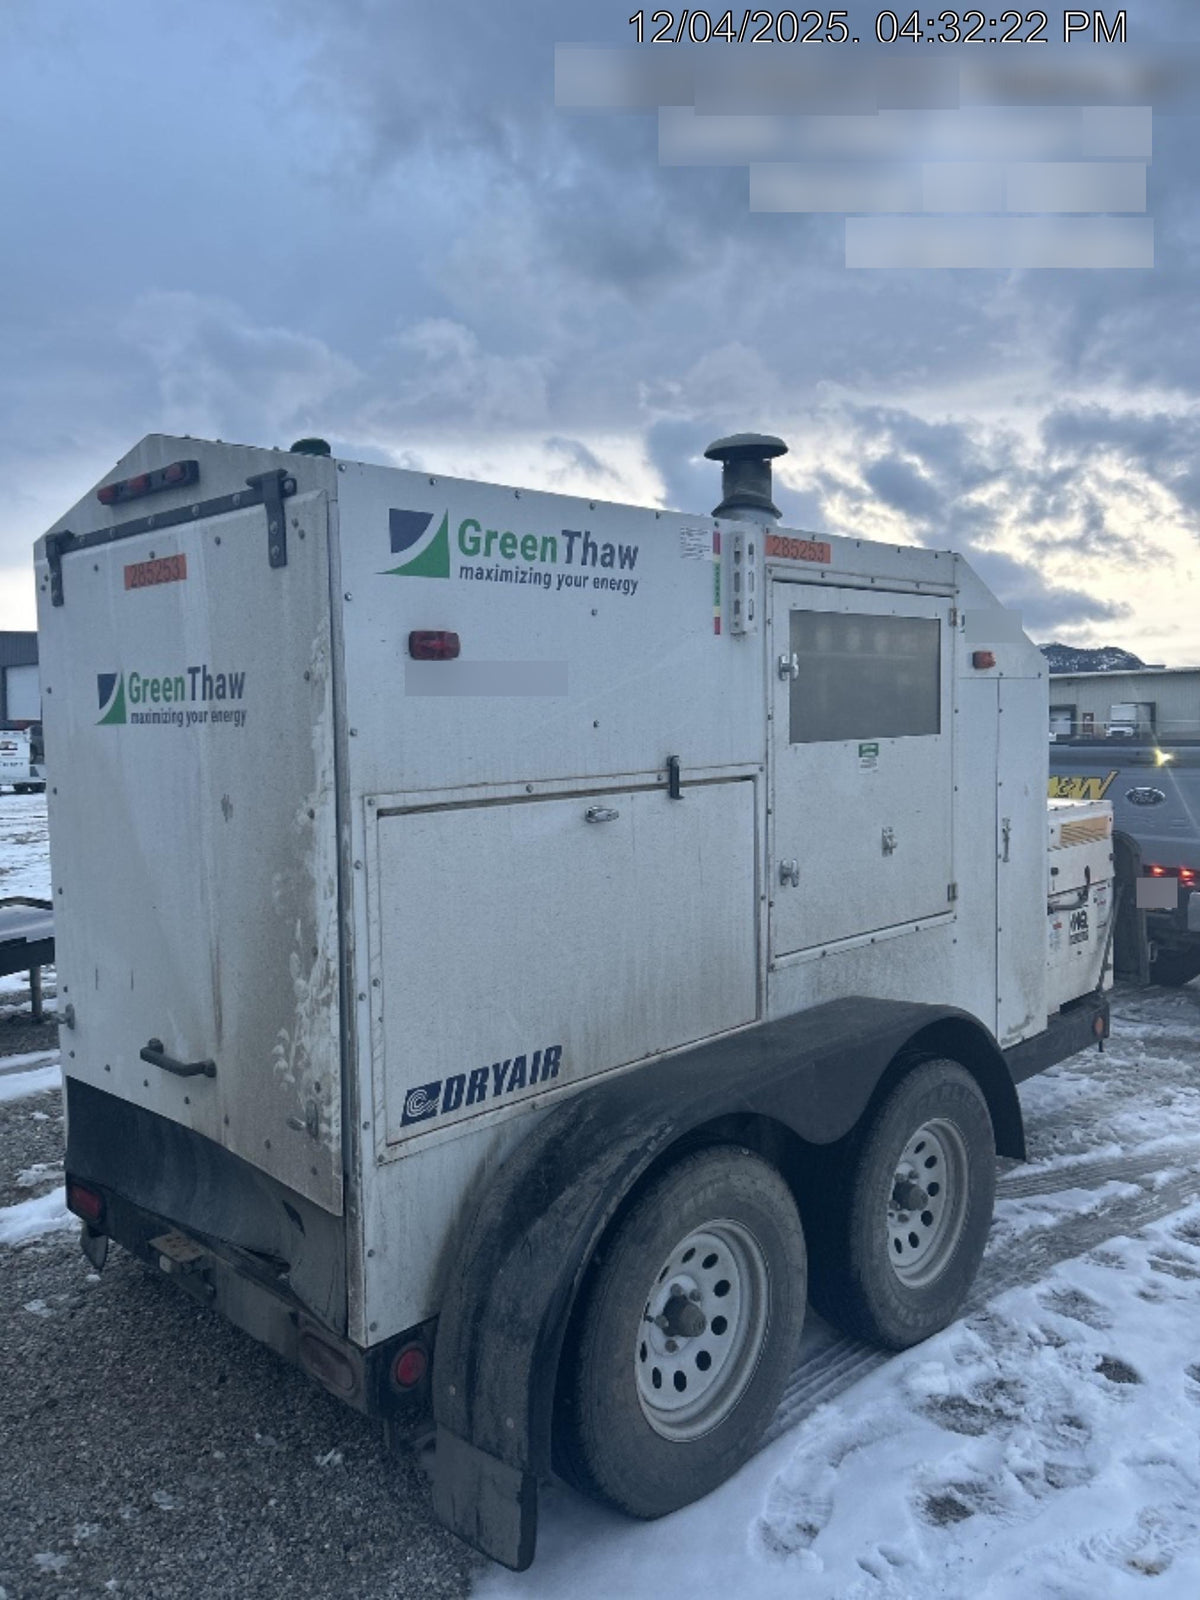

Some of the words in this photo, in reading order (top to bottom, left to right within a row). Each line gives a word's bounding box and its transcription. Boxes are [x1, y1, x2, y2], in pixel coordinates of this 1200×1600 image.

[772, 536, 824, 562] 285253
[131, 556, 180, 589] 285253
[459, 564, 552, 590] maximizing
[556, 573, 588, 590] your
[593, 575, 638, 596] energy
[131, 707, 183, 727] maximizing
[186, 710, 208, 727] your
[211, 709, 247, 727] energy
[441, 1045, 563, 1114] DRYAIR
